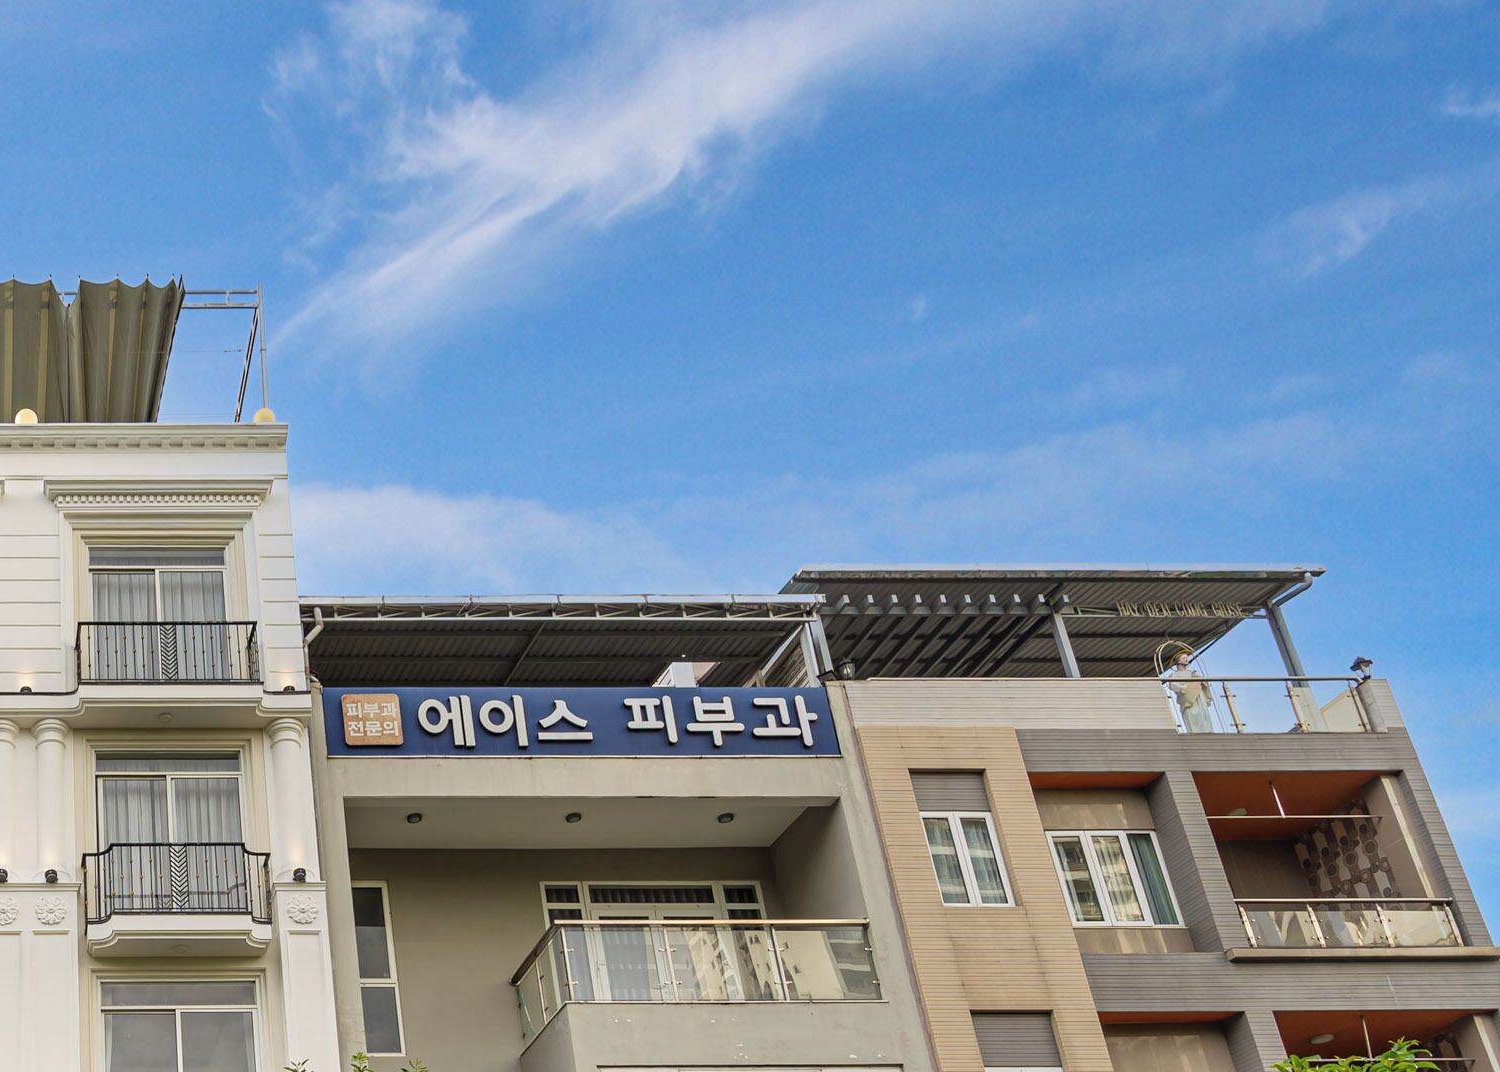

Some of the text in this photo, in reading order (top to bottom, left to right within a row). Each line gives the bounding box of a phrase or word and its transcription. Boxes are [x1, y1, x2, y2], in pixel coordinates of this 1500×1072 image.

[346, 701, 398, 719] 피부과
[348, 720, 400, 738] 전문의
[417, 694, 818, 748] 에이스 피부과
